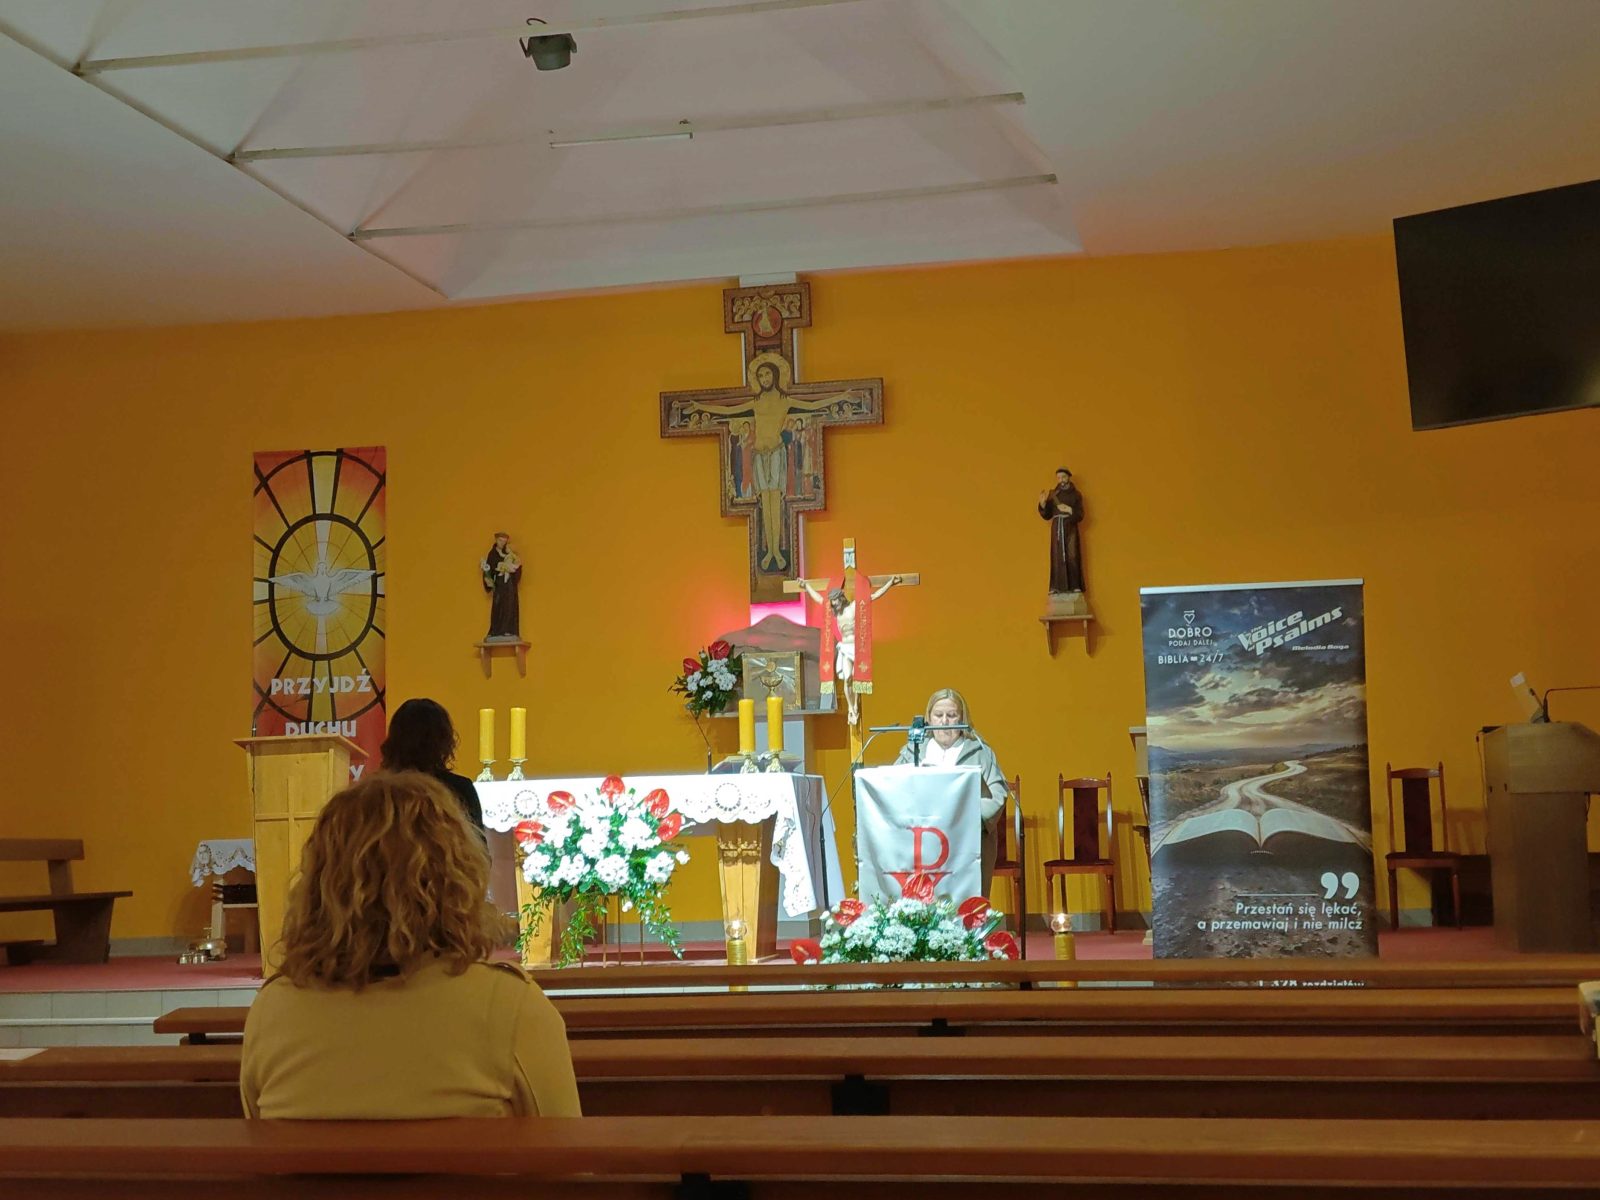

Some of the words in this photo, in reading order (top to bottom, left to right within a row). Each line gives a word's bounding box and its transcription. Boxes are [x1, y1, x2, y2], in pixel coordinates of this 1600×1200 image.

[1168, 627, 1212, 638] DOBRO
[1238, 610, 1303, 651] Voice
[1255, 606, 1343, 656] Psalms
[1158, 655, 1189, 664] BIBLIA
[1200, 650, 1224, 663] 24/7
[271, 668, 372, 695] PRZYJDŹ
[285, 720, 357, 737] DUCHU
[1236, 902, 1293, 915] Przestań
[1298, 903, 1316, 918] się
[1321, 902, 1362, 918] lękać,
[1197, 920, 1206, 930] a
[1211, 918, 1289, 932] przemawiaj
[1294, 918, 1298, 930] i
[1303, 918, 1323, 930] nie
[1328, 917, 1363, 930] milcz
